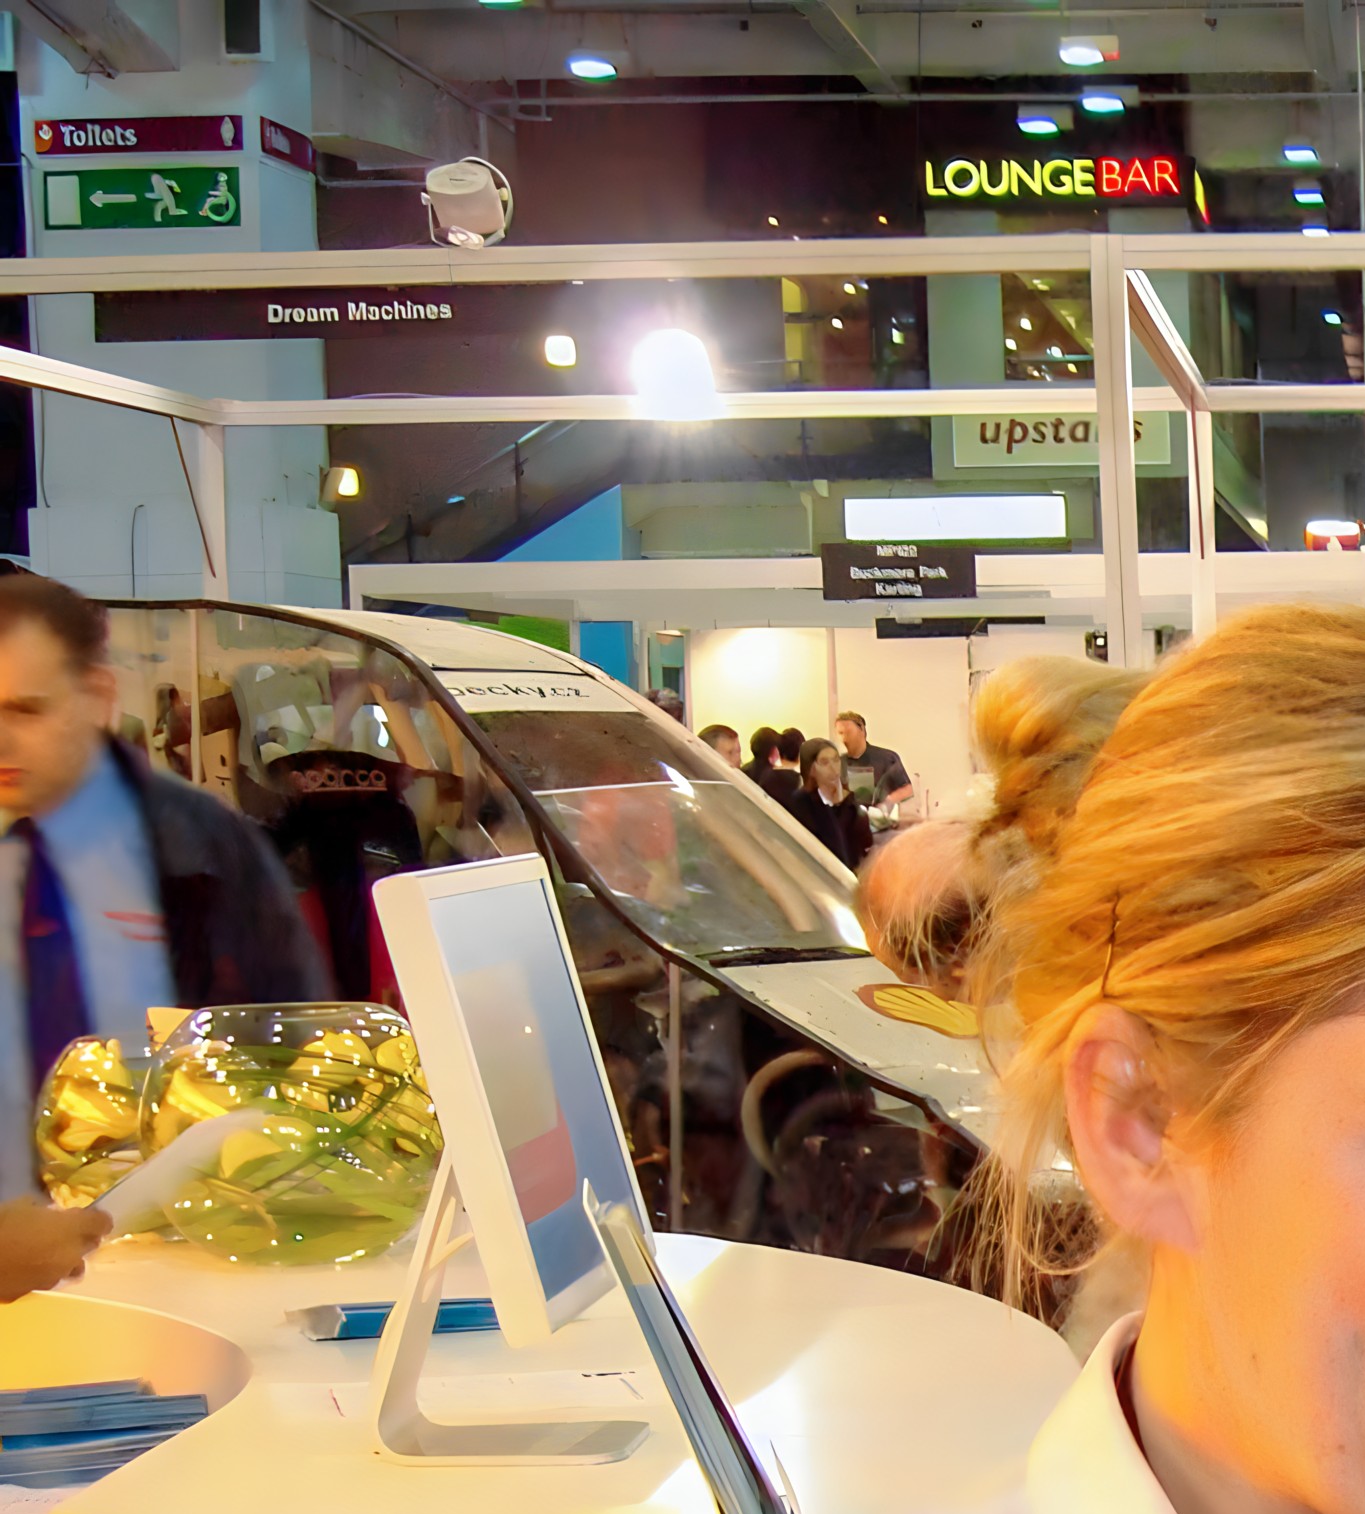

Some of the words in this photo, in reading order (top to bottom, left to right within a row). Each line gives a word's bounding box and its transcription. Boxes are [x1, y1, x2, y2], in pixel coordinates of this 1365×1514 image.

[267, 303, 340, 323] Dream
[347, 300, 453, 321] Machines
[979, 417, 1144, 455] upstas
